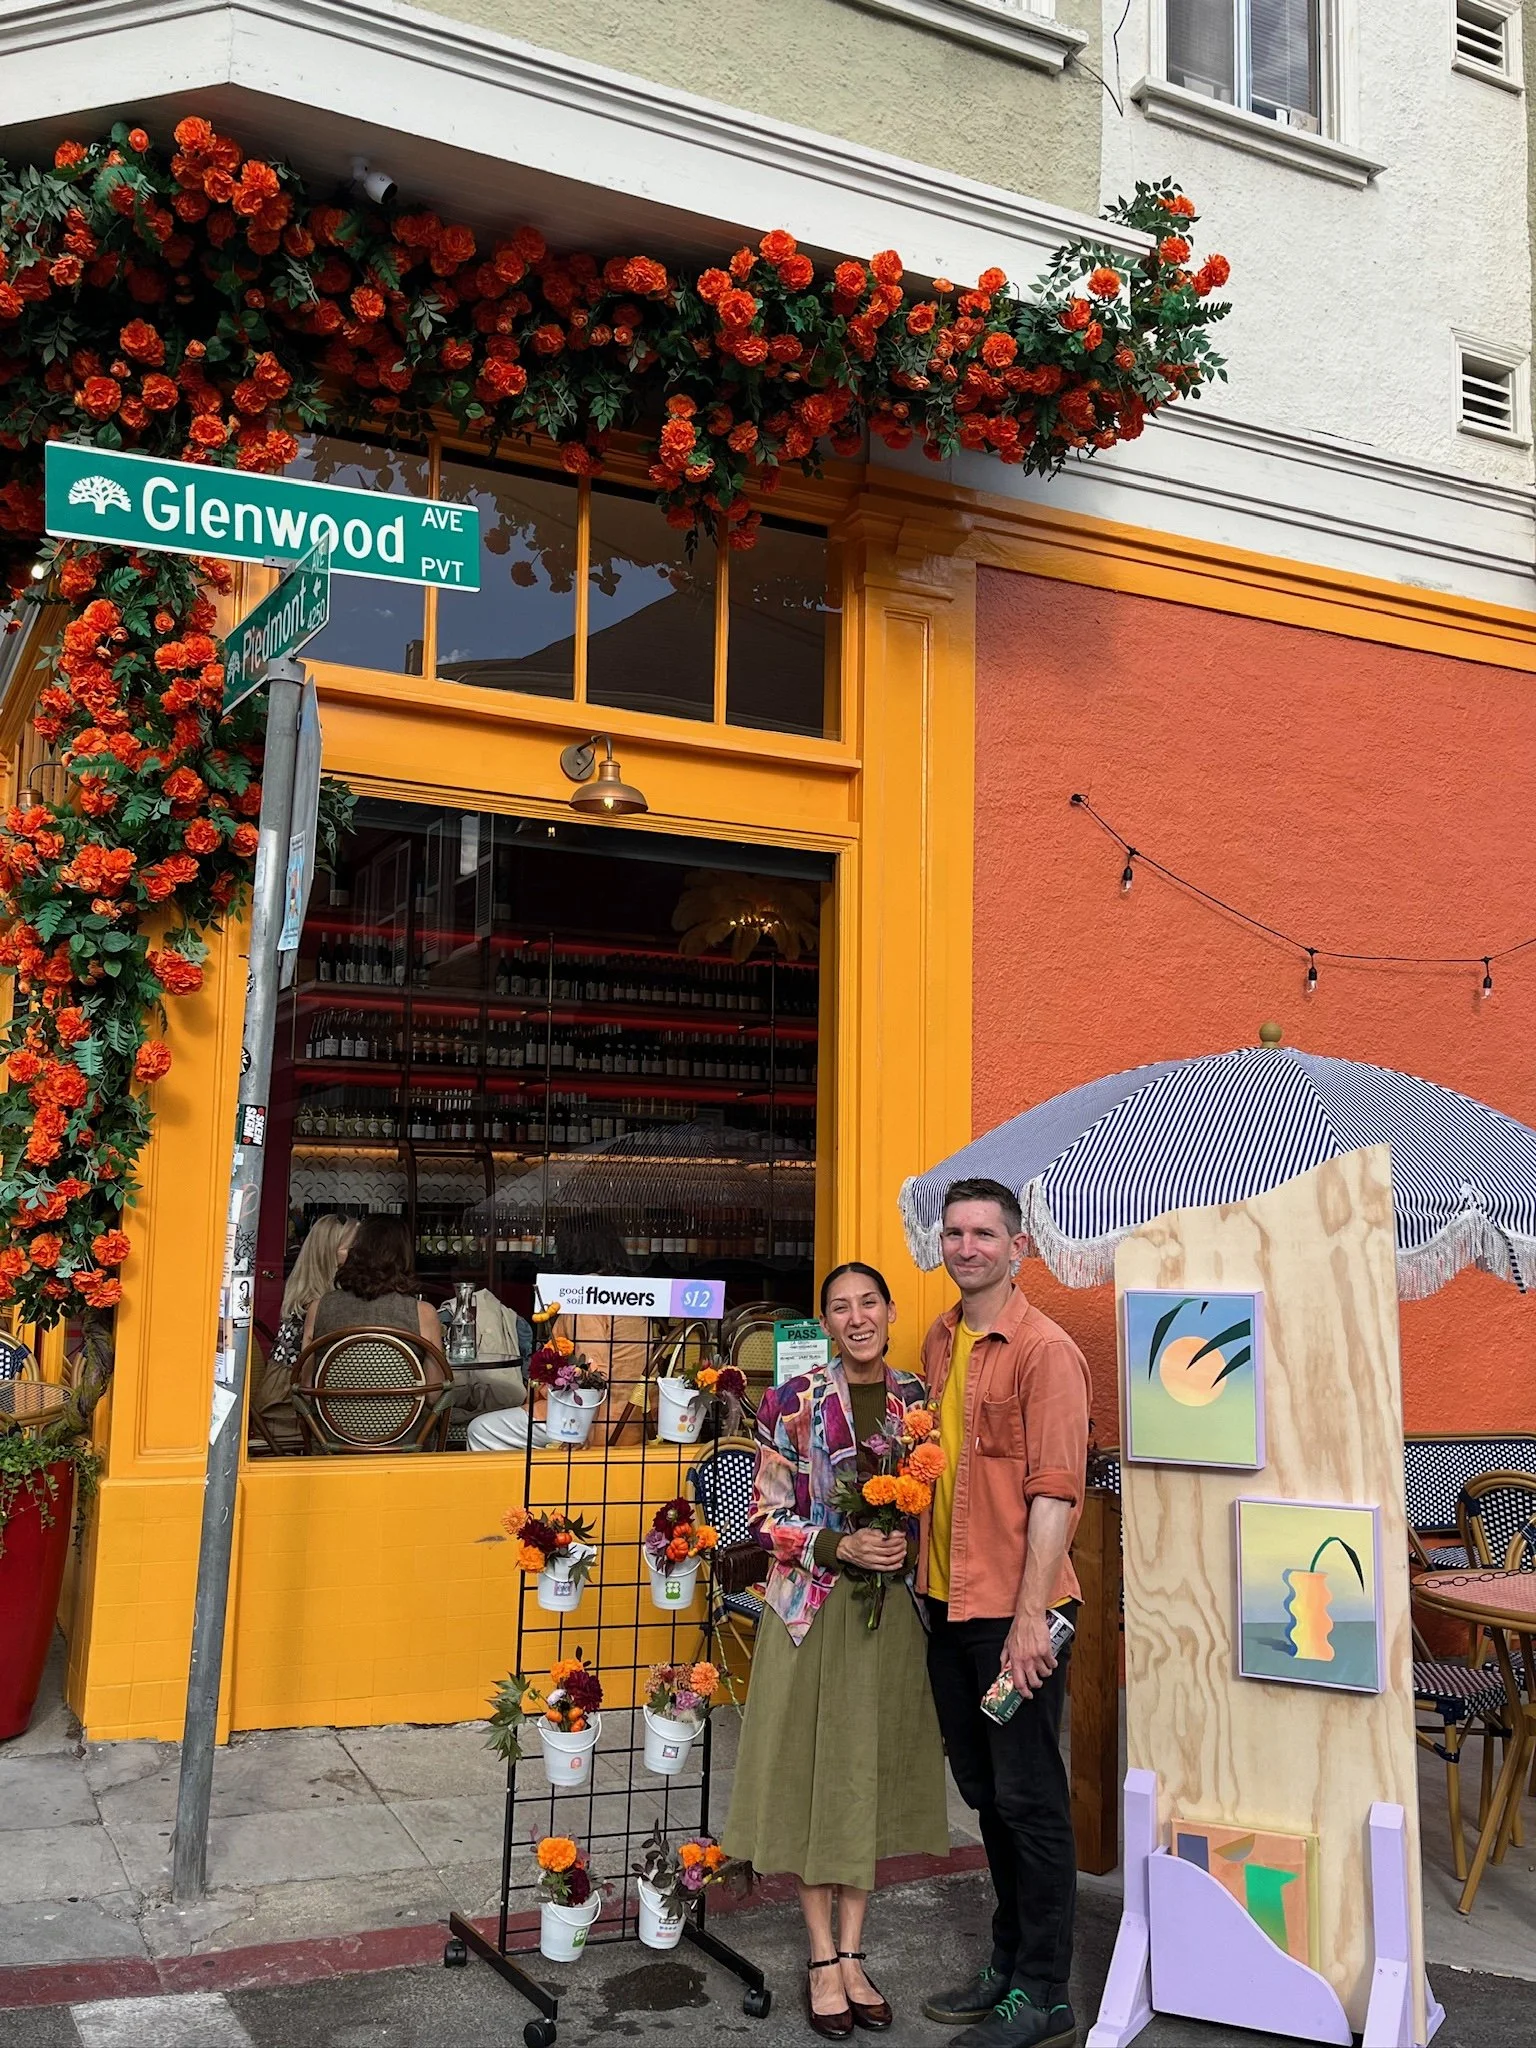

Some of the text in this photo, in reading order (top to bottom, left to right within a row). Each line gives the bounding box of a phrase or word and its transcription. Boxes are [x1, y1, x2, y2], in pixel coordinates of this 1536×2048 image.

[142, 476, 405, 564] Glenwood
[421, 507, 464, 533] AVE
[421, 556, 464, 583] PVT
[241, 574, 307, 681] Piedmont
[306, 598, 326, 632] 4250
[559, 1286, 584, 1296] good
[566, 1295, 584, 1305] soil
[586, 1286, 655, 1307] flowers
[787, 1328, 817, 1340] PASS
